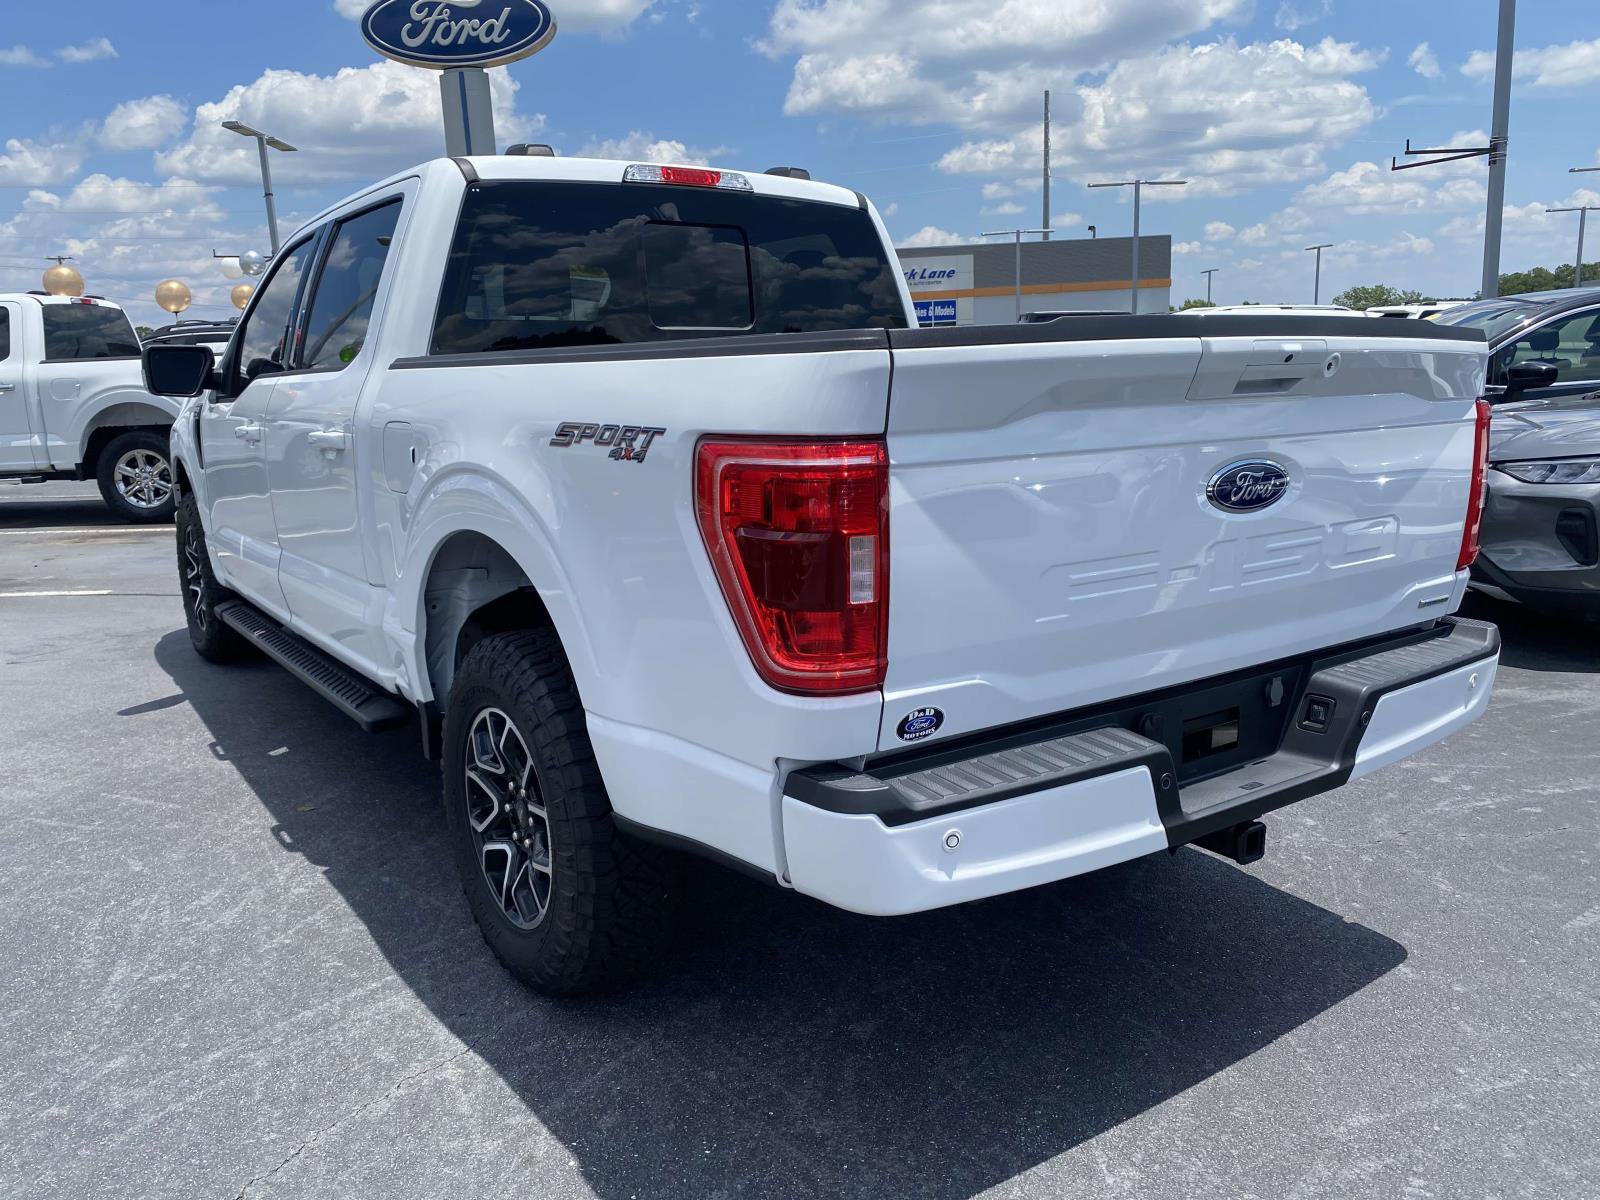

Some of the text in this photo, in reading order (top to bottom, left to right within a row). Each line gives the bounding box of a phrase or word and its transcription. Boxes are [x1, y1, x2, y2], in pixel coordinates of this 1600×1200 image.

[400, 0, 512, 48] Ford
[920, 268, 956, 279] Lane
[935, 305, 955, 316] Models
[549, 421, 667, 448] SPORT
[1230, 471, 1275, 501] Ford
[910, 719, 931, 730] Ford
